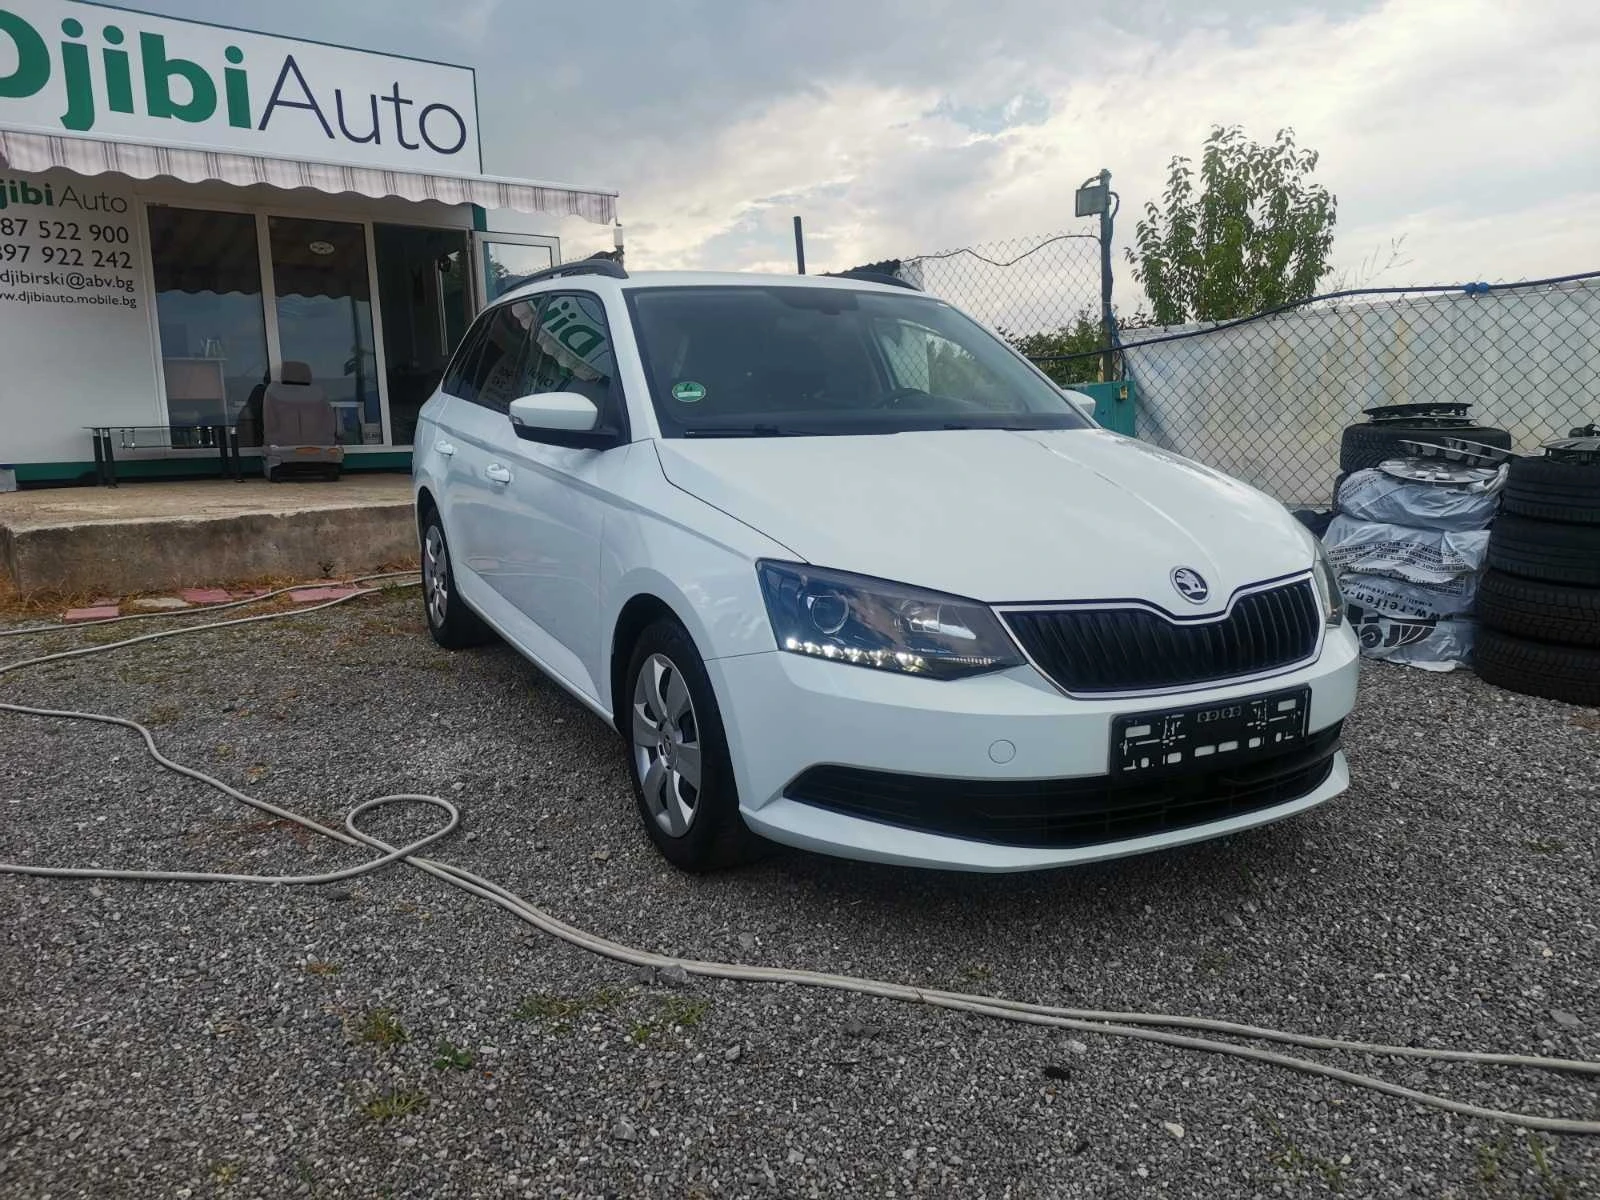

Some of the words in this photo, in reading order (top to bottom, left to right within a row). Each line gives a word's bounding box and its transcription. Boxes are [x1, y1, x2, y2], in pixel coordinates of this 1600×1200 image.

[58, 185, 128, 213] Auto
[0, 218, 28, 236] 87
[39, 220, 82, 241] 522
[89, 224, 129, 244] 900
[0, 243, 31, 263] 97
[42, 246, 84, 267] 922
[91, 249, 133, 269] 242
[0, 269, 135, 292] djibirski@abv.bg
